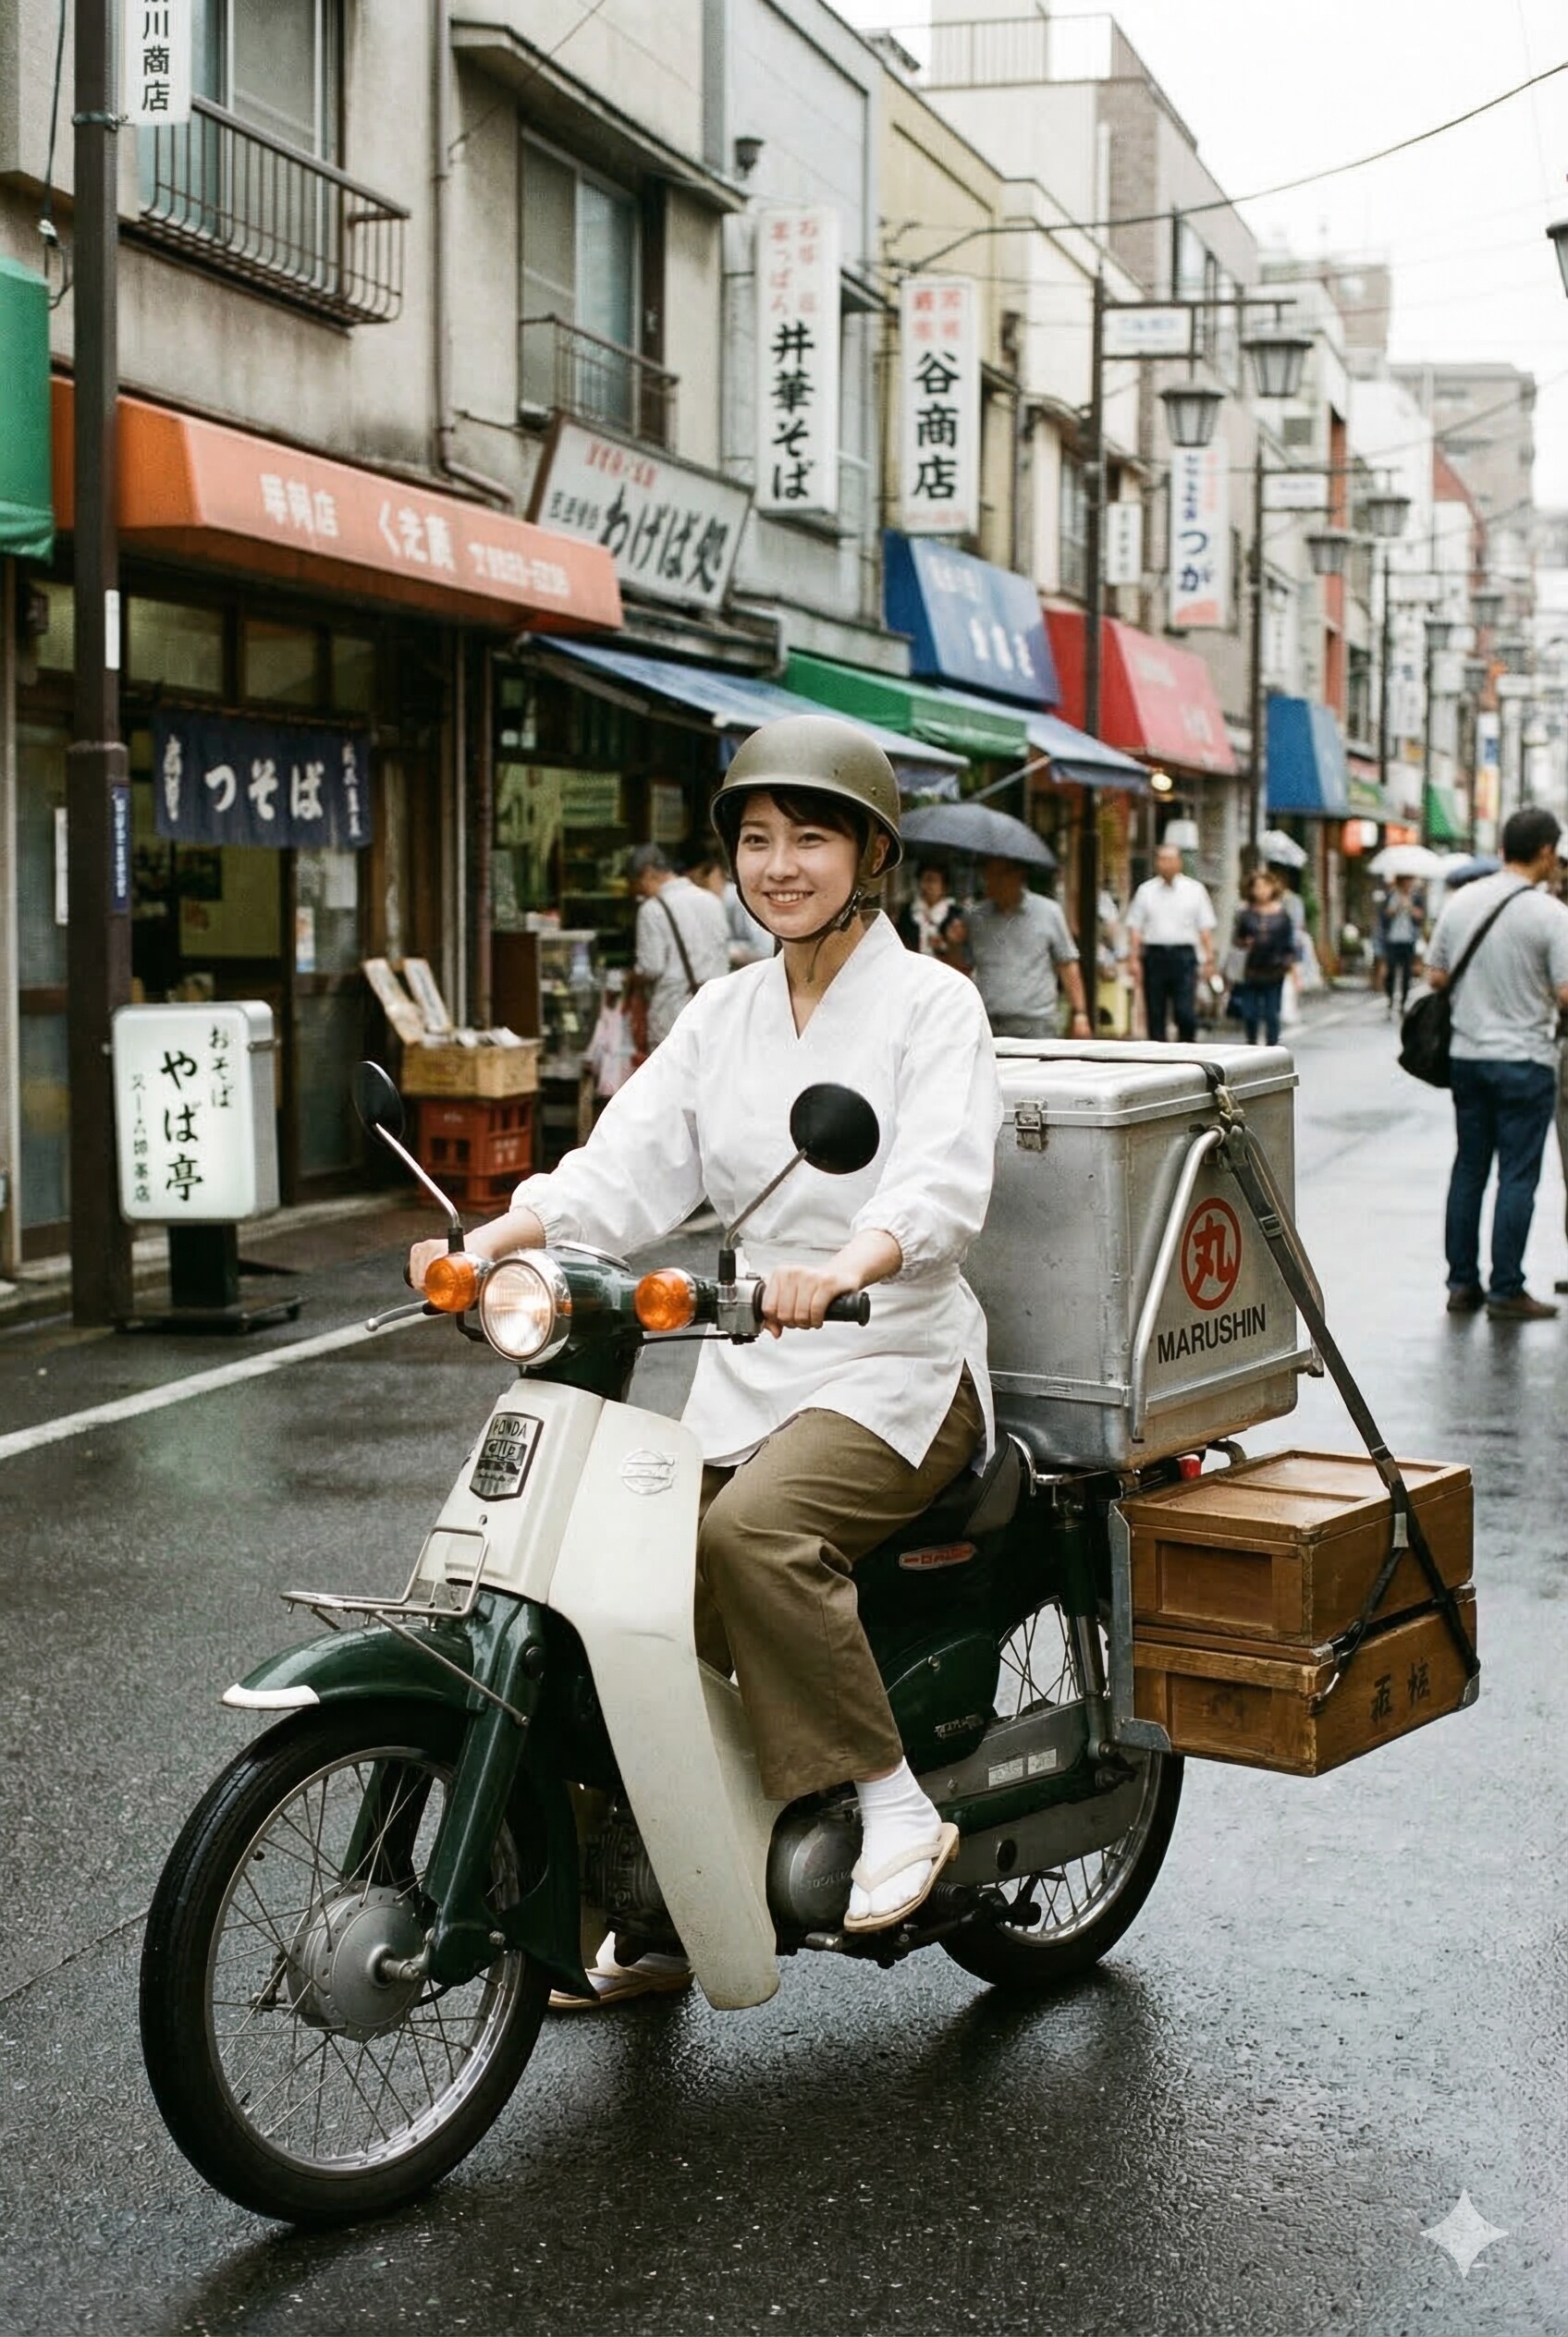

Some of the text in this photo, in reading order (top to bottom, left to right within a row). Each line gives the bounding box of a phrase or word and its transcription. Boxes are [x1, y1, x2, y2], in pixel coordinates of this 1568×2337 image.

[141, 0, 170, 112] 川商店
[913, 351, 961, 499] 谷商店
[204, 758, 325, 821] つそば
[210, 1025, 234, 1108] おそば
[161, 1050, 203, 1202] やば亭
[1190, 1211, 1237, 1298] 丸
[1158, 1303, 1266, 1364] MARUSHIN
